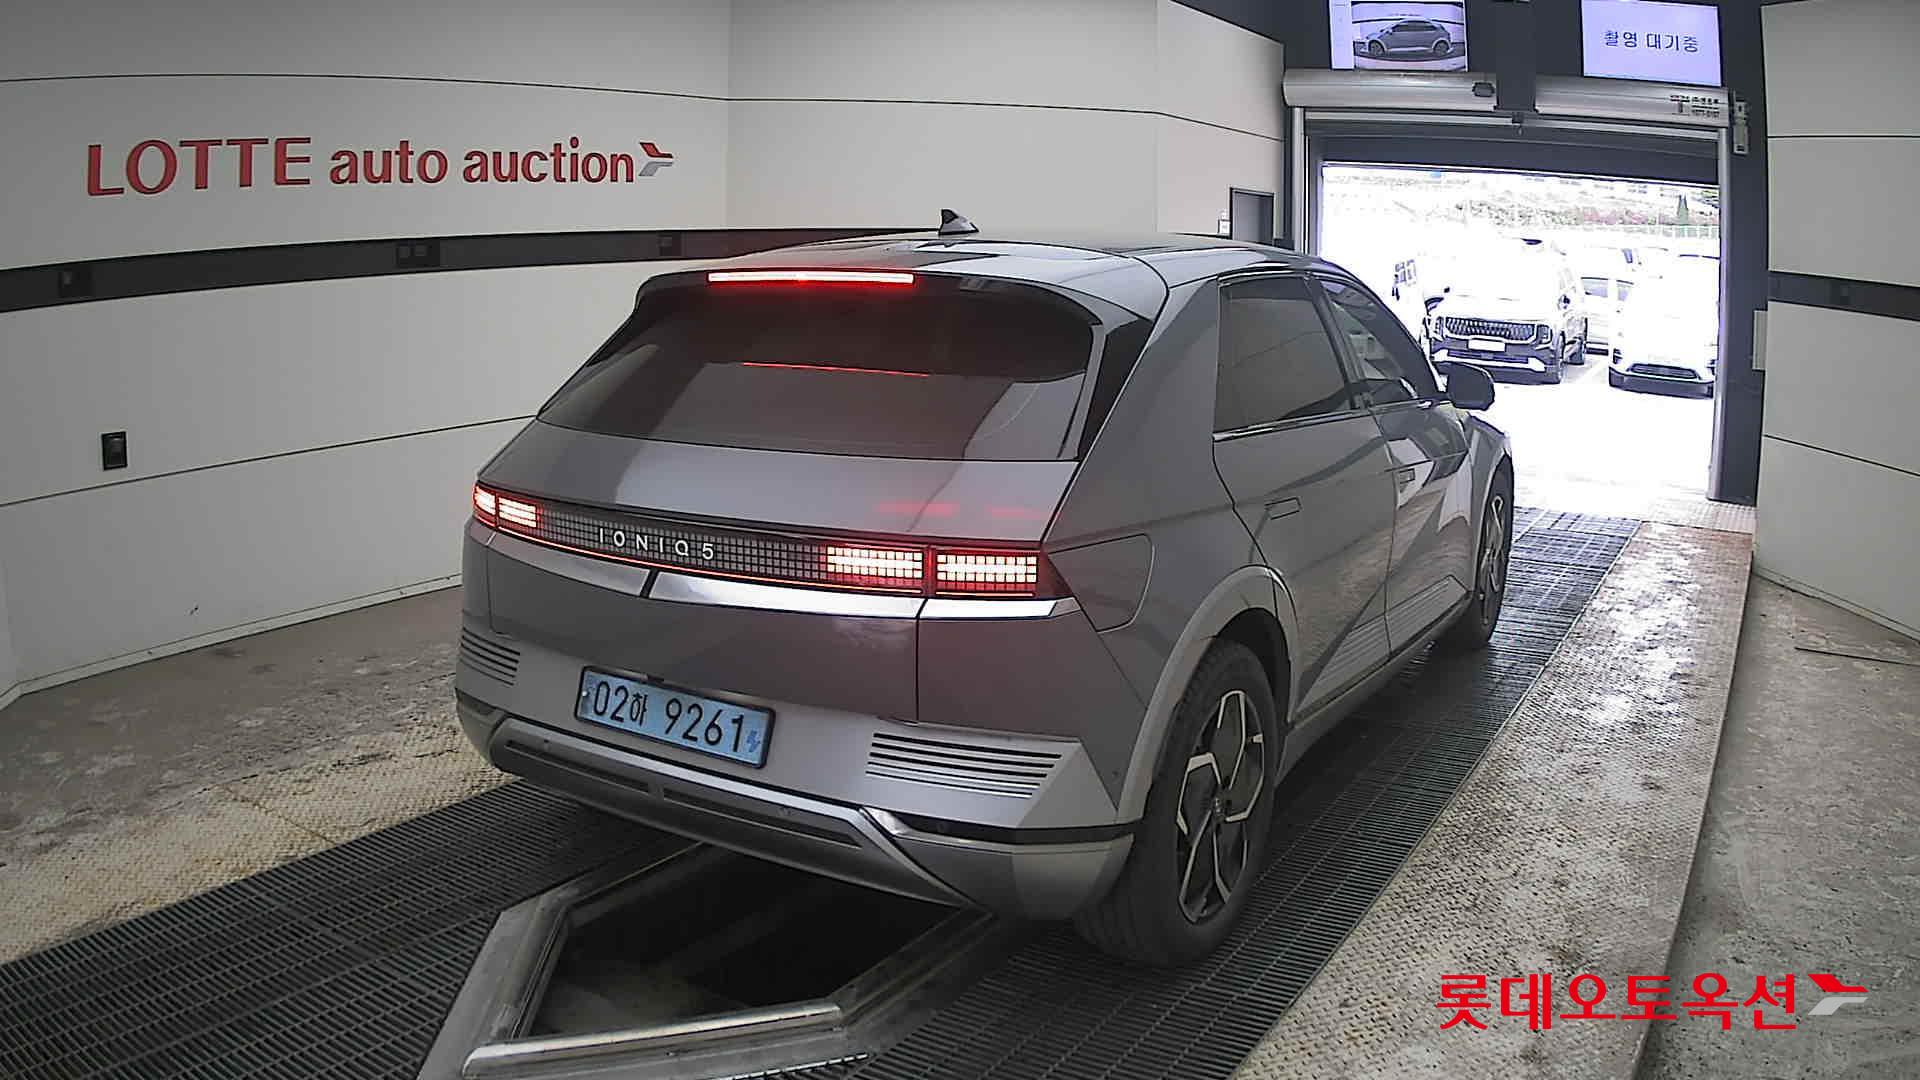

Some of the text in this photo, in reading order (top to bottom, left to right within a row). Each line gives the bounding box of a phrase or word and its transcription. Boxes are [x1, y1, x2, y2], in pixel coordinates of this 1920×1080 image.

[1605, 31, 1698, 53] 촬영 대기중
[87, 136, 635, 196] LOTTE auto auction
[599, 527, 715, 561] IONIQ 5
[593, 681, 746, 753] 02하 9261
